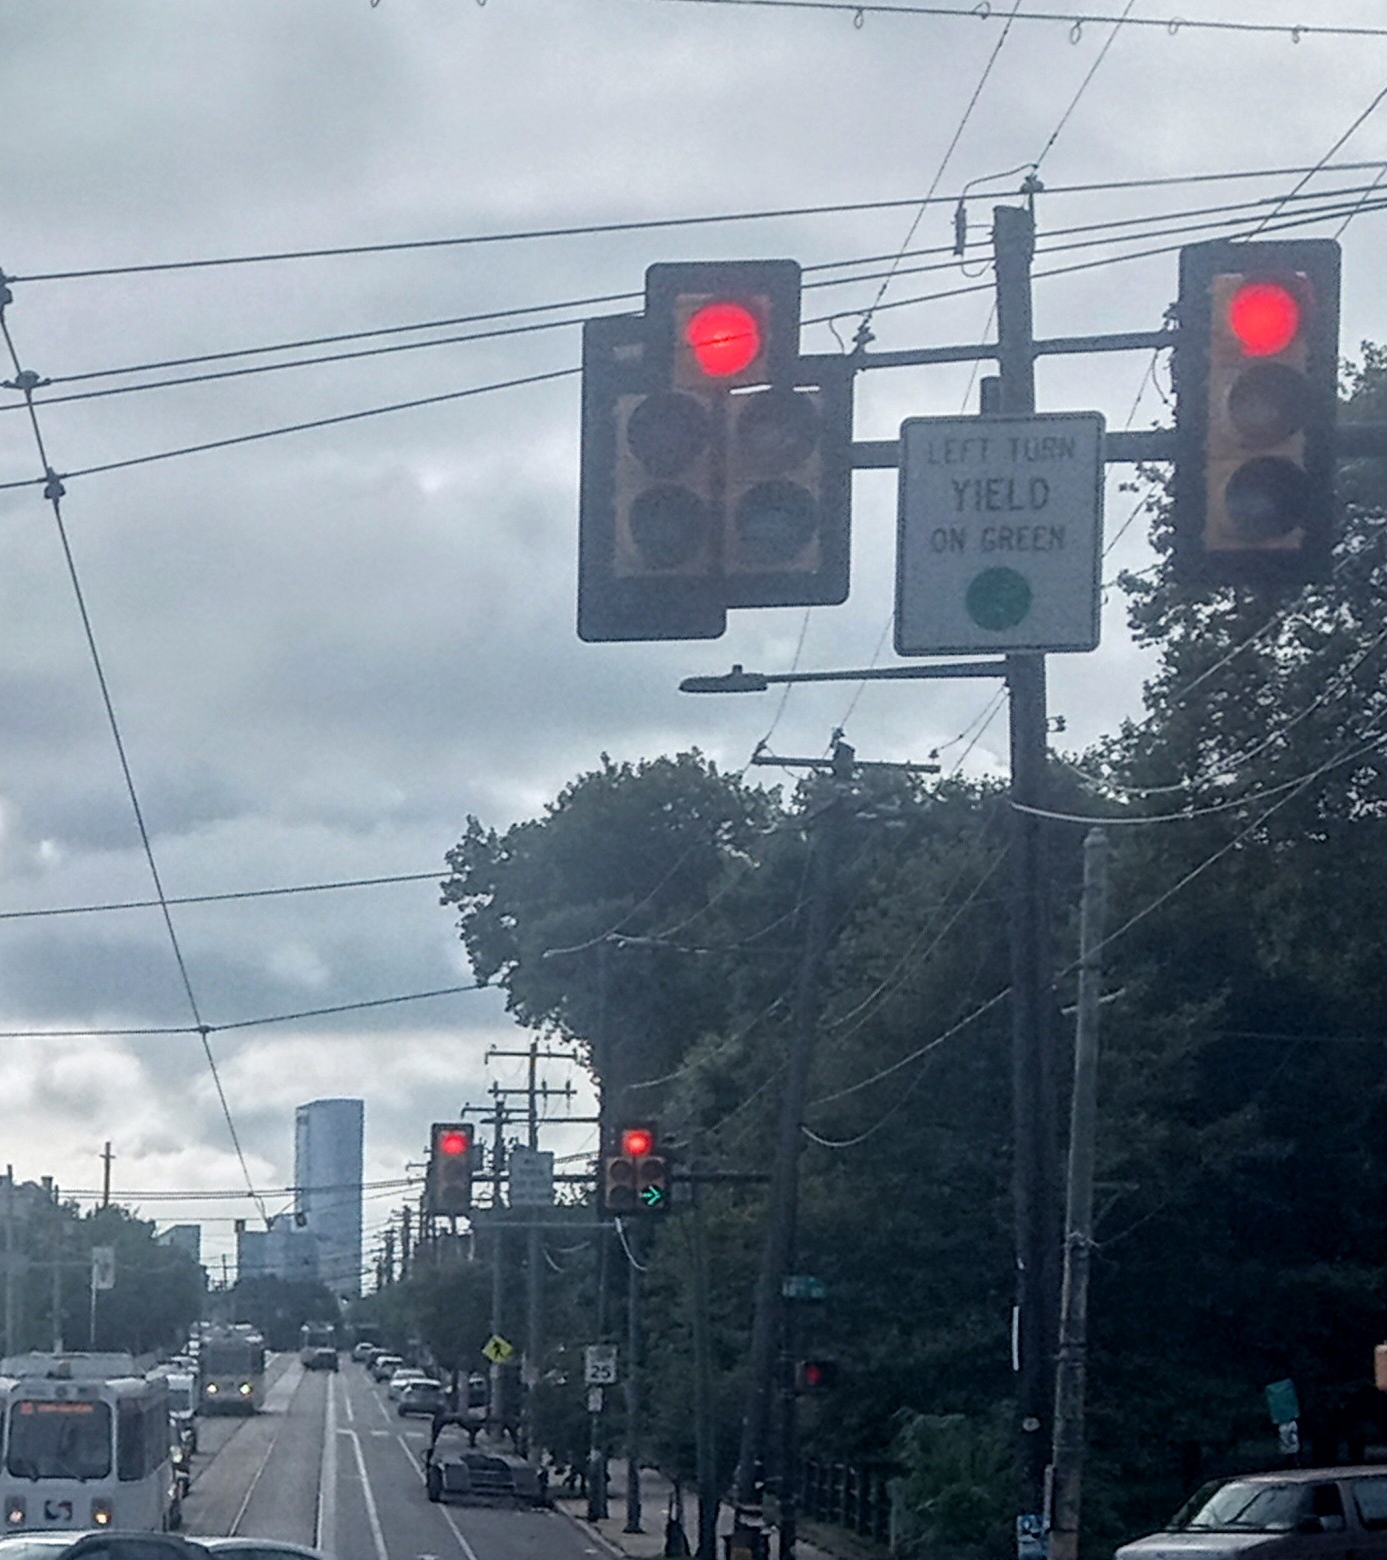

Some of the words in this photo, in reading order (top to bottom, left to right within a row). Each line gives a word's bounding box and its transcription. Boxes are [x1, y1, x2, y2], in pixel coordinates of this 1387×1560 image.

[928, 436, 989, 465] LEFT
[1007, 434, 1077, 463] TURN
[951, 476, 1051, 513] YIELD
[930, 526, 966, 555] ON
[981, 525, 1067, 554] GREEN
[591, 1365, 612, 1379] 25
